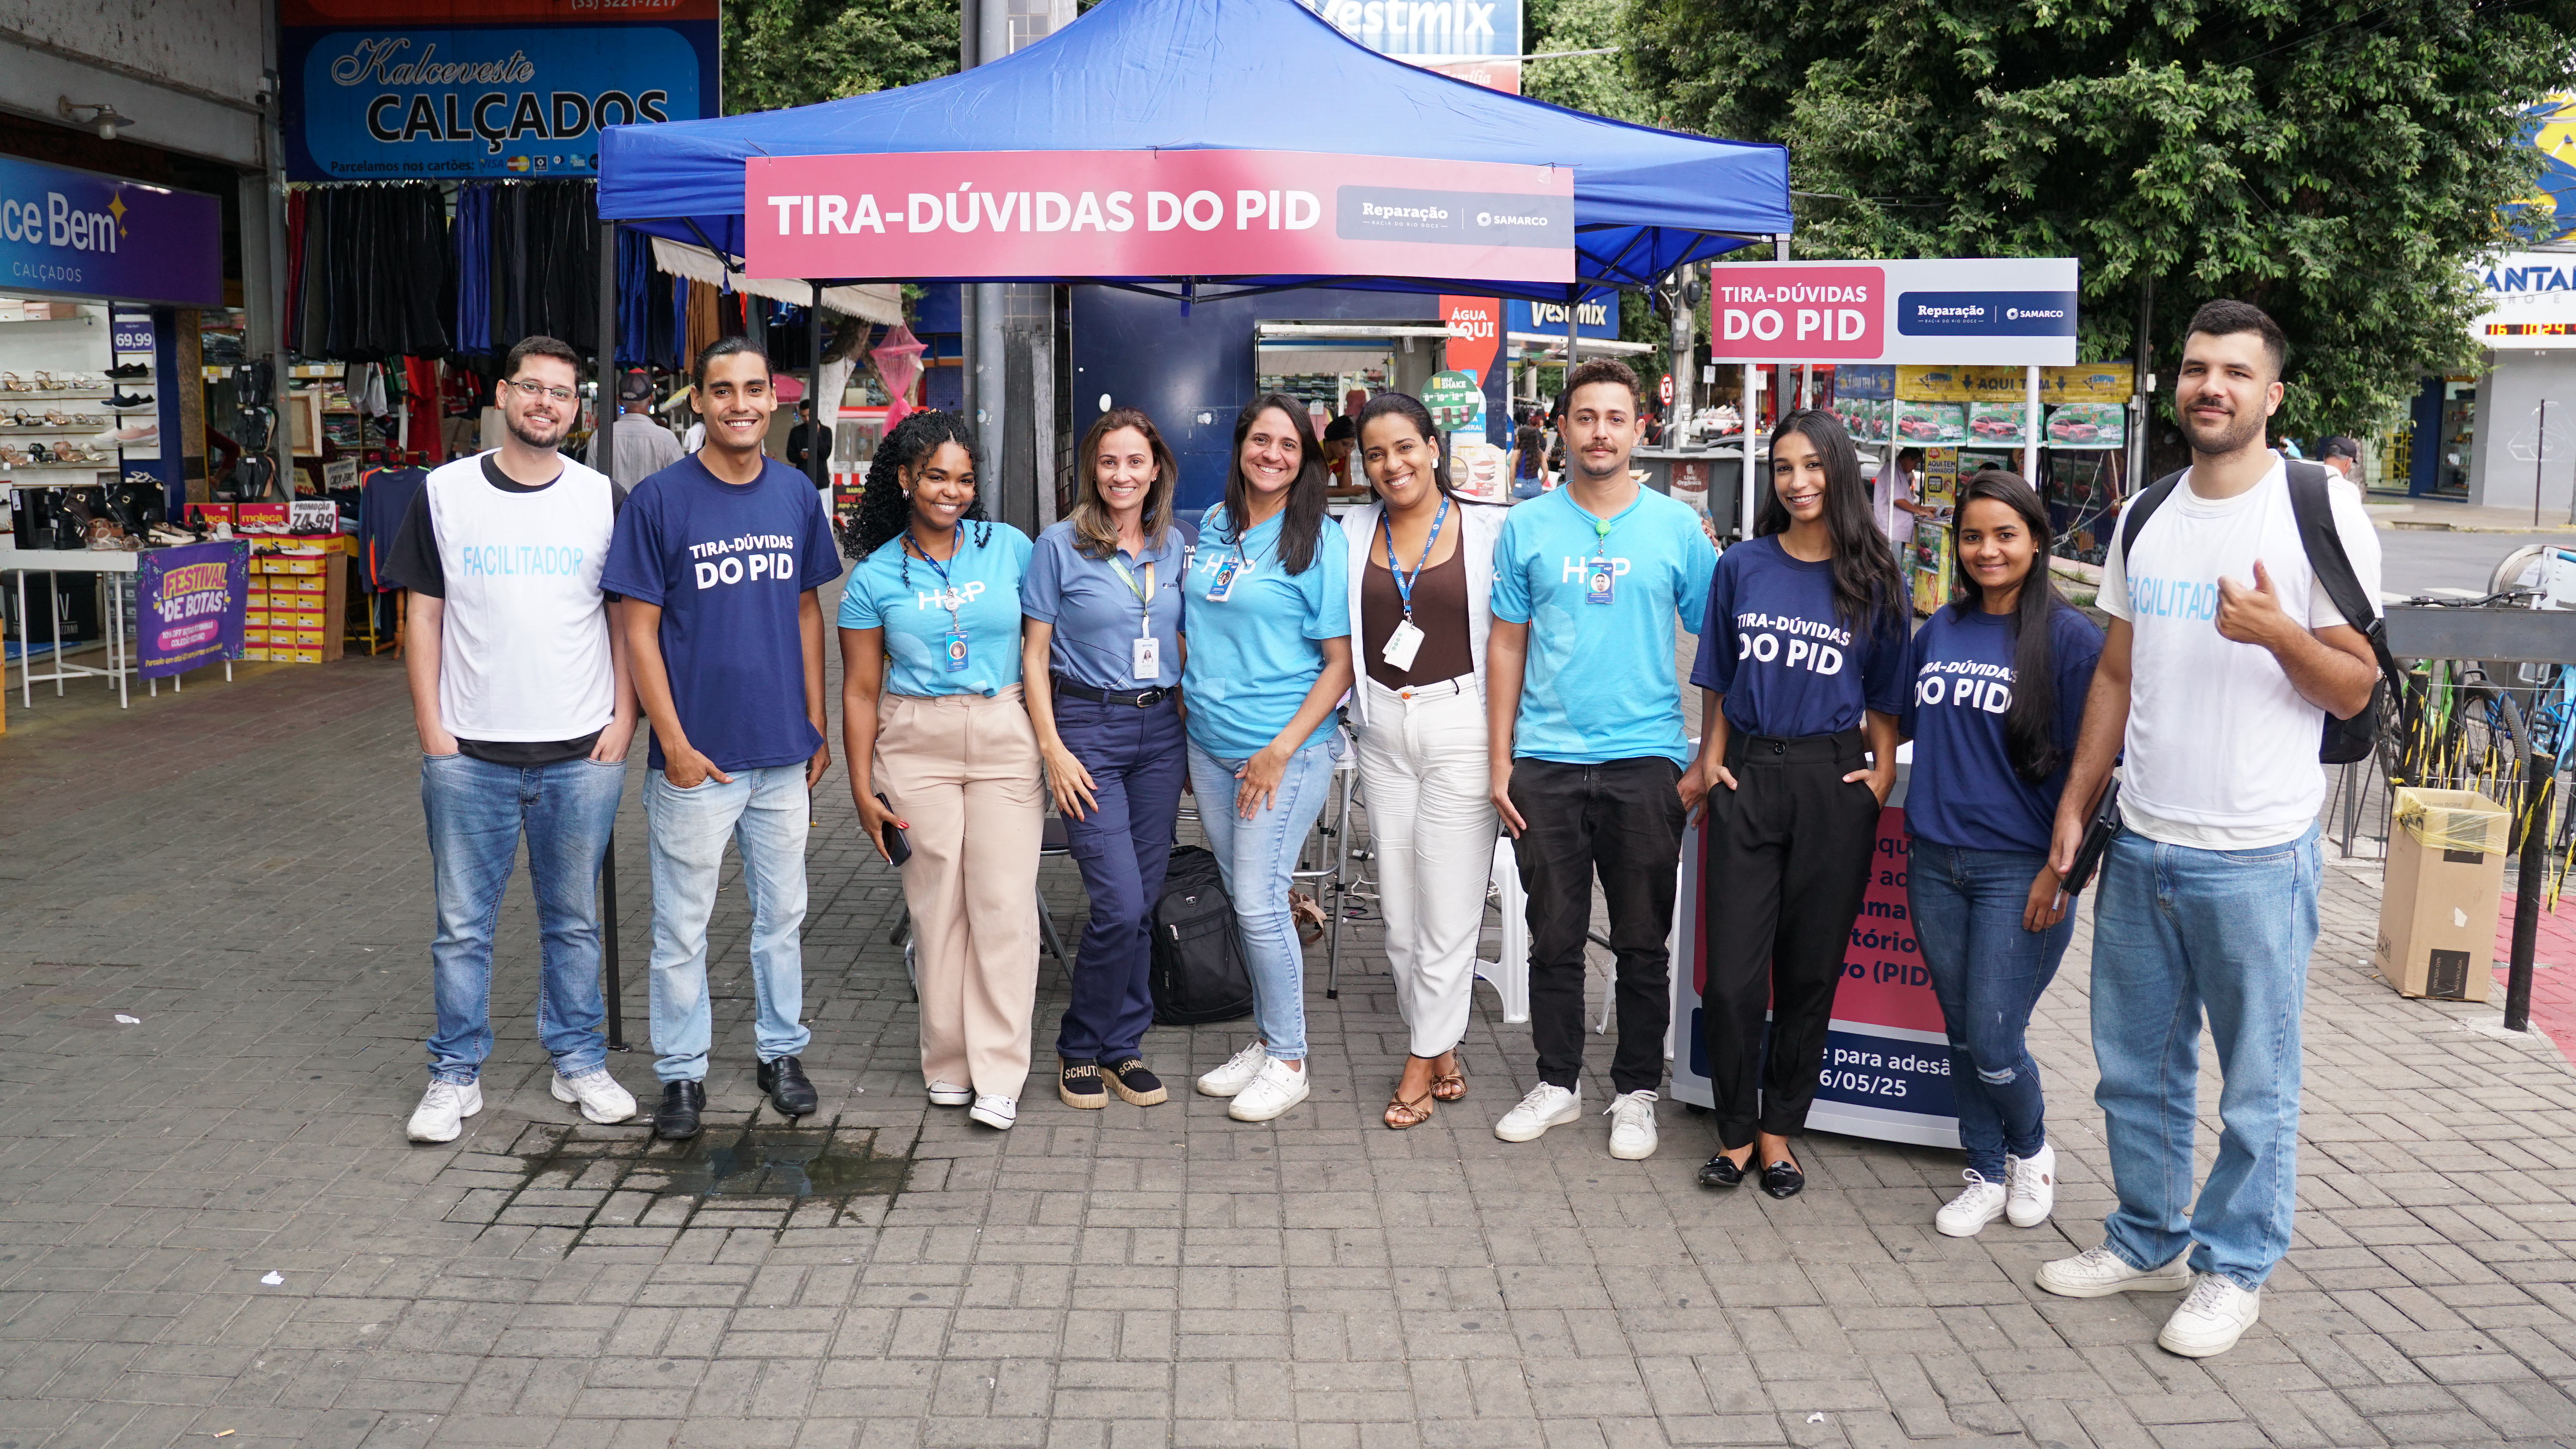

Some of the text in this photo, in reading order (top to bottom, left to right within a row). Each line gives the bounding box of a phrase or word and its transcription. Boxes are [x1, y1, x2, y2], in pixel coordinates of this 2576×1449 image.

[331, 37, 535, 85] Kalceveste
[367, 90, 669, 155] CALÇADOS
[331, 159, 474, 172] Parcelamos nos cartões:
[768, 182, 1321, 235] TIRA-DÚVIDAS DO PID
[1362, 202, 1448, 221] Reparação
[1494, 215, 1548, 226] SAMARCO
[0, 191, 115, 253] ce Bem
[13, 261, 82, 282] CALÇADOS
[1721, 282, 1867, 303] TIRA-DÚVIDAS
[1451, 307, 1487, 321] ÁGUA
[1918, 305, 1984, 318] Reparação
[1446, 321, 1494, 341] AQUI
[1723, 308, 1865, 342] DO PID
[2490, 324, 2508, 335] 16
[115, 333, 152, 349] 69,99
[1441, 381, 1467, 389] SHAKE
[1978, 378, 2049, 391] AQUI TM
[242, 512, 283, 522] moleca
[295, 501, 330, 513] PROMOÇÃO
[689, 533, 793, 559] TIRA-DÚVIDAS
[463, 545, 583, 577] FACILITADOR
[694, 552, 793, 590] DO PID
[1200, 553, 1256, 577] HP
[1562, 556, 1631, 585] HP
[164, 564, 227, 600] FESTIVAL
[164, 597, 184, 623] DE
[2127, 576, 2221, 621] FACILITAD
[1738, 612, 1851, 646] TIRA-DÚVIDAS
[1786, 639, 1843, 675] PID
[1953, 678, 2012, 714] PID
[1834, 1049, 1882, 1067] para
[1819, 1069, 1907, 1097] 6/05/25
